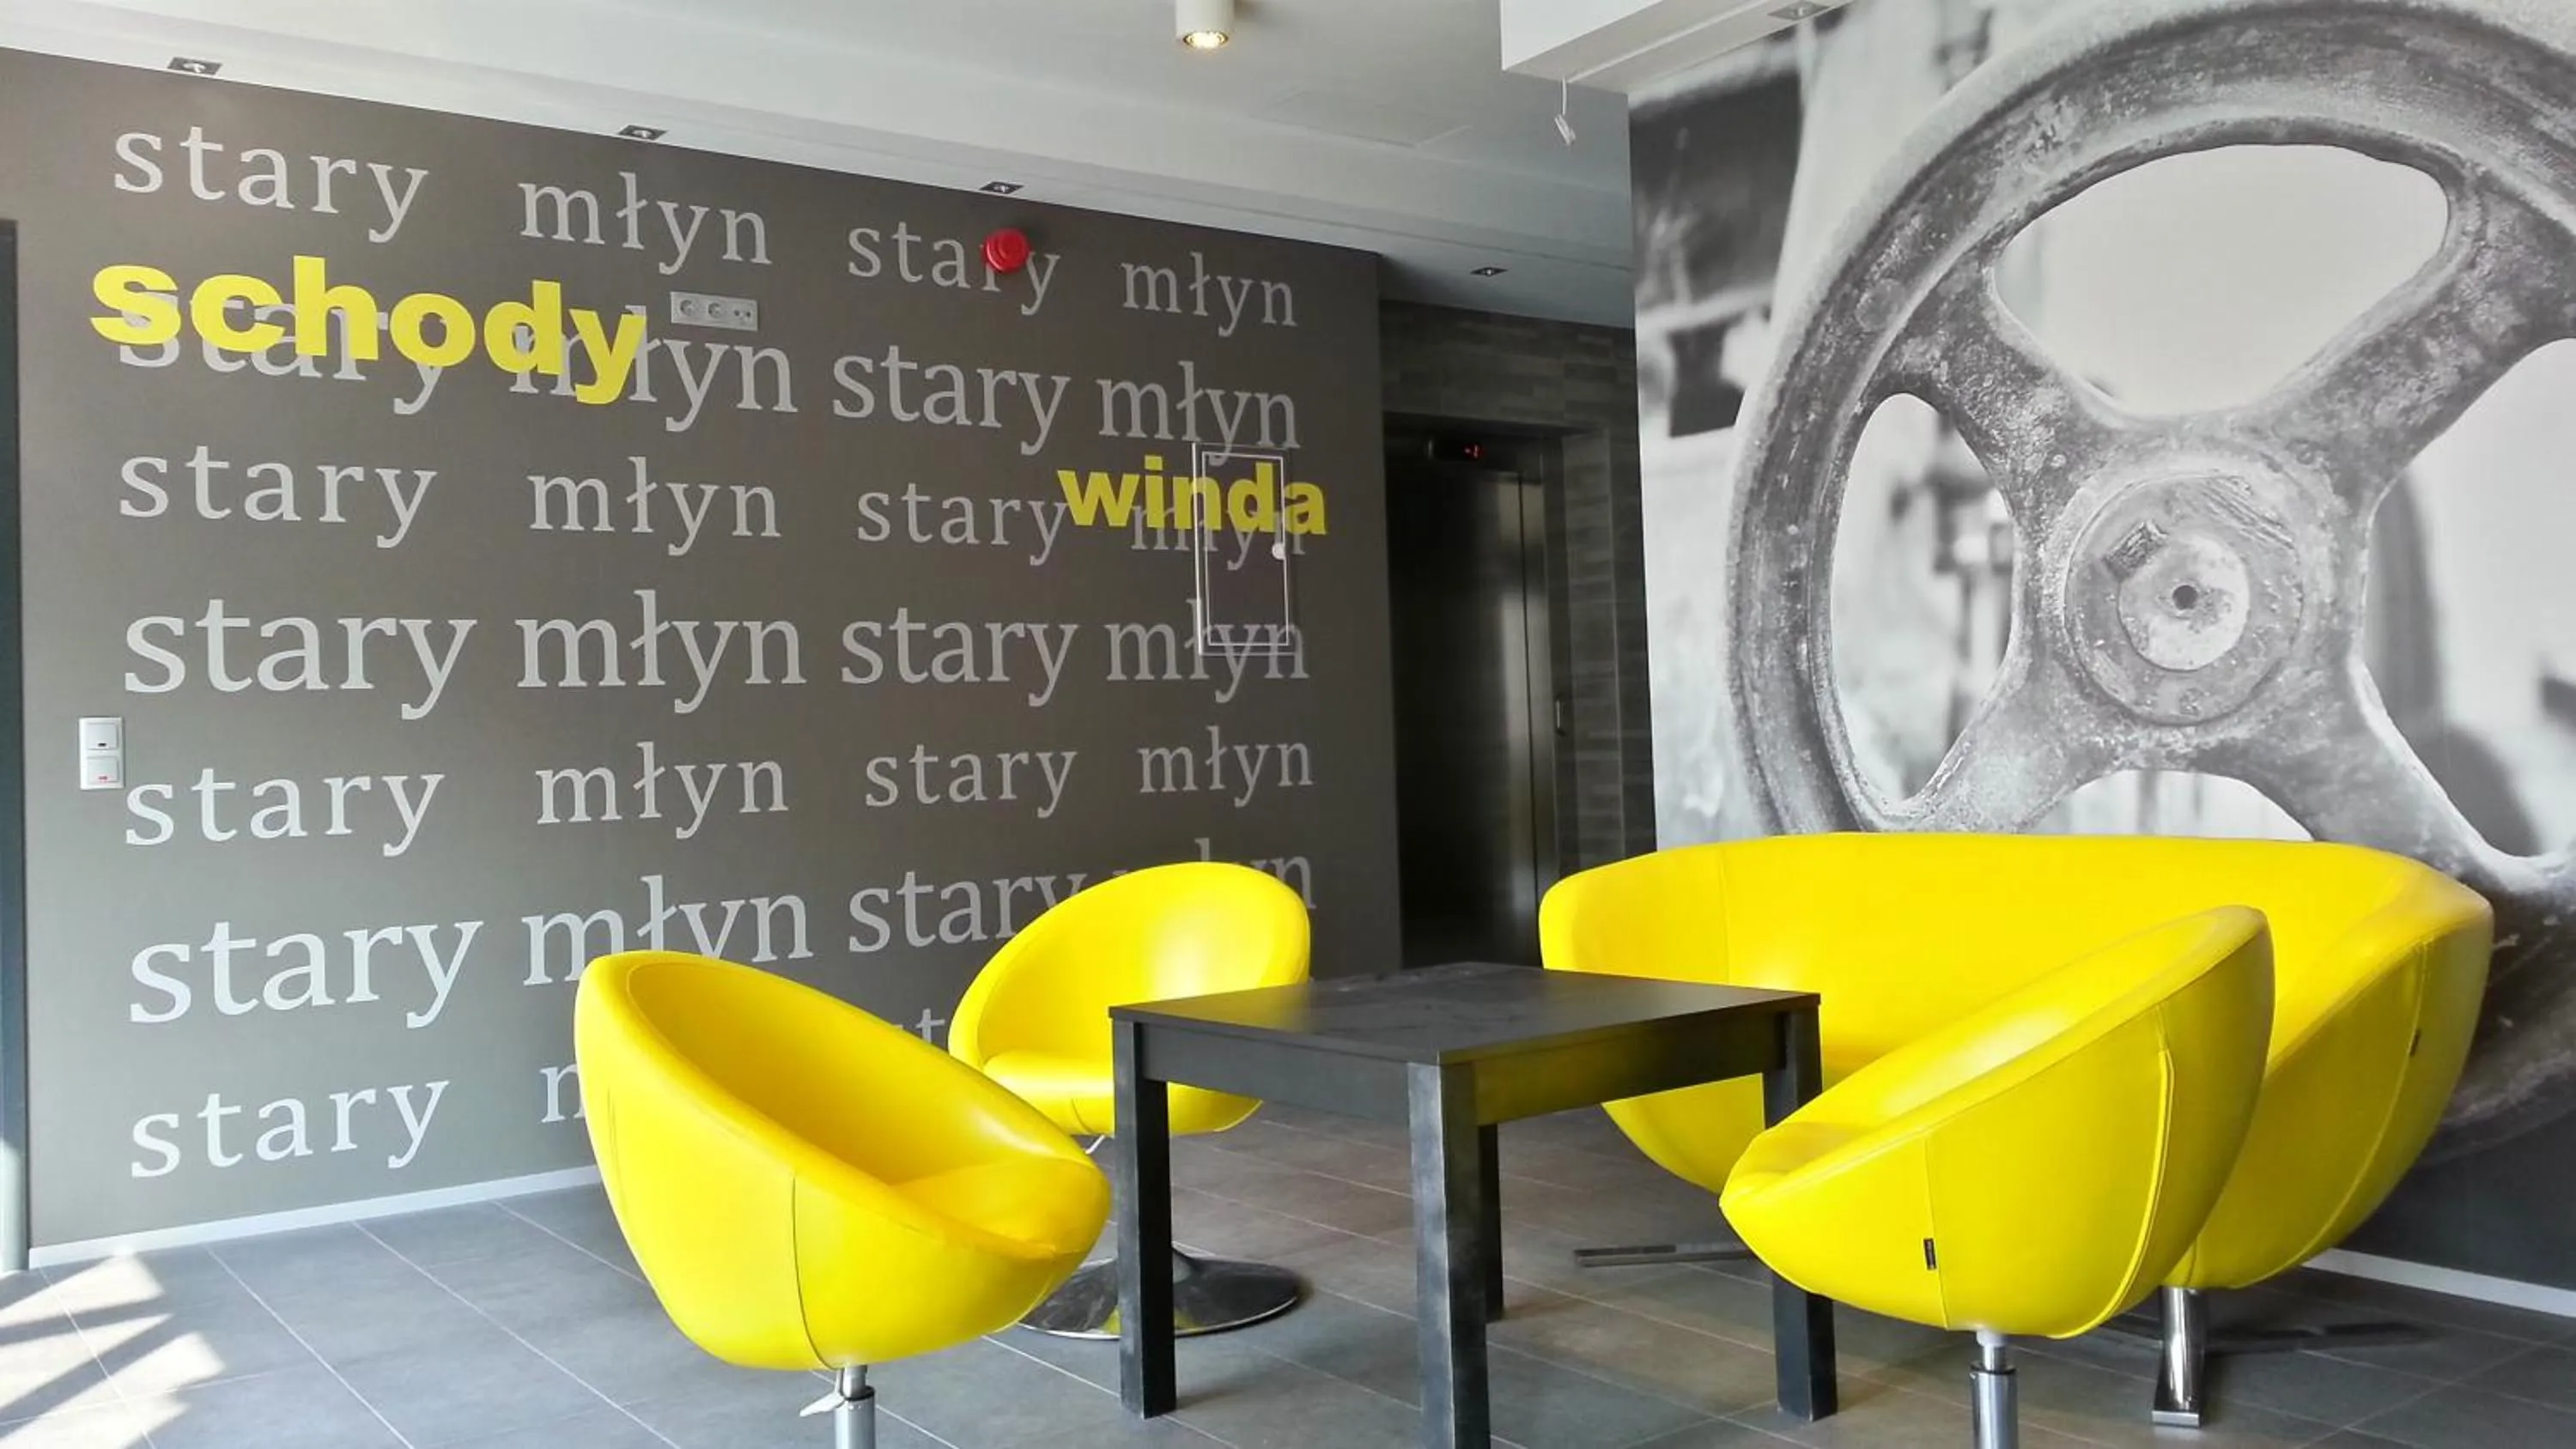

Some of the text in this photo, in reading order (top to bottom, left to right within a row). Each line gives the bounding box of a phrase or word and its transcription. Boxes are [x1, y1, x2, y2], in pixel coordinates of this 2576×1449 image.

[115, 127, 428, 242] stary
[519, 172, 771, 275] młyn
[1121, 252, 1296, 336] młyn
[90, 255, 647, 404] schody
[834, 346, 1071, 455] stary
[1097, 361, 1300, 464] młyn
[121, 446, 437, 548] stary
[527, 457, 781, 555] młyn
[859, 483, 1070, 566] stary
[1057, 454, 1327, 535] winda
[125, 590, 1309, 719] stary młyn stary młyn
[126, 725, 1313, 856] stary młyn stary młyn
[131, 921, 483, 1028] stary
[131, 1080, 450, 1178] stary
